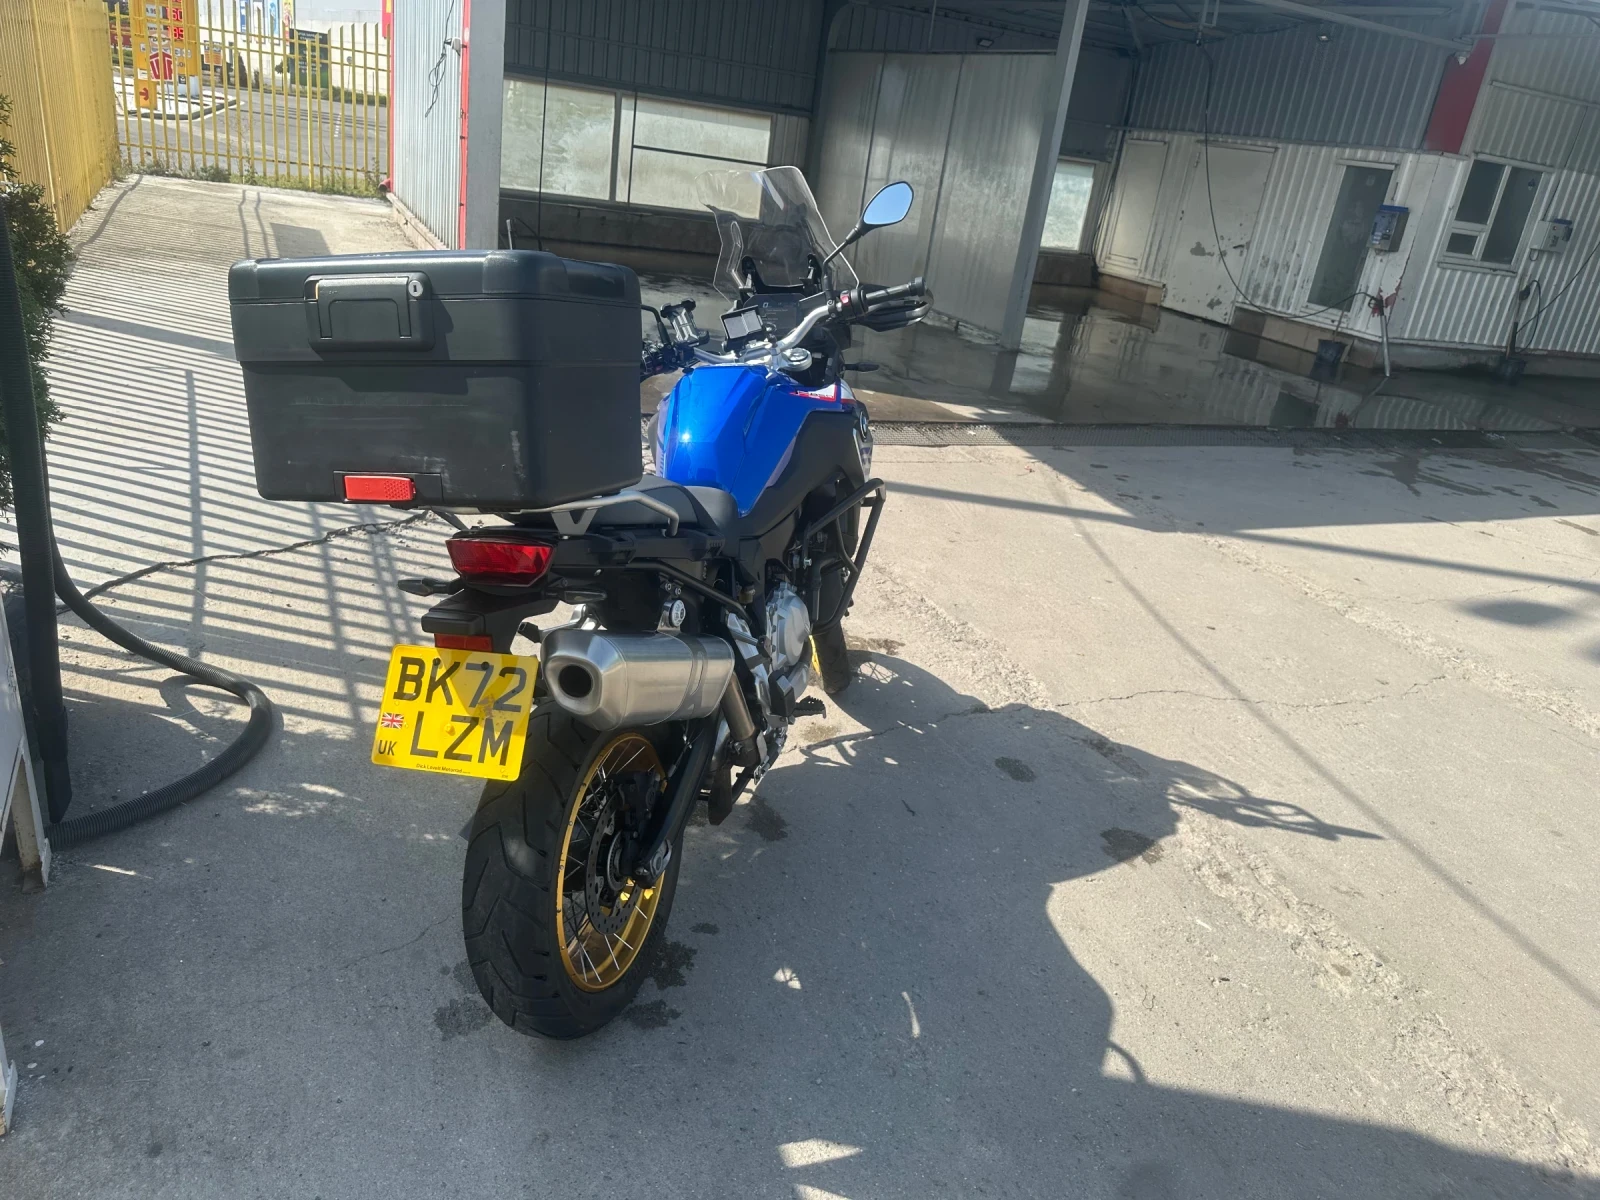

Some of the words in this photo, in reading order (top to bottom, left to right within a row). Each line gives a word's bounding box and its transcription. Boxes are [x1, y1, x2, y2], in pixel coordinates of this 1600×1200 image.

[393, 656, 527, 713] BK72
[378, 740, 397, 756] UK
[410, 711, 514, 766] LZM
